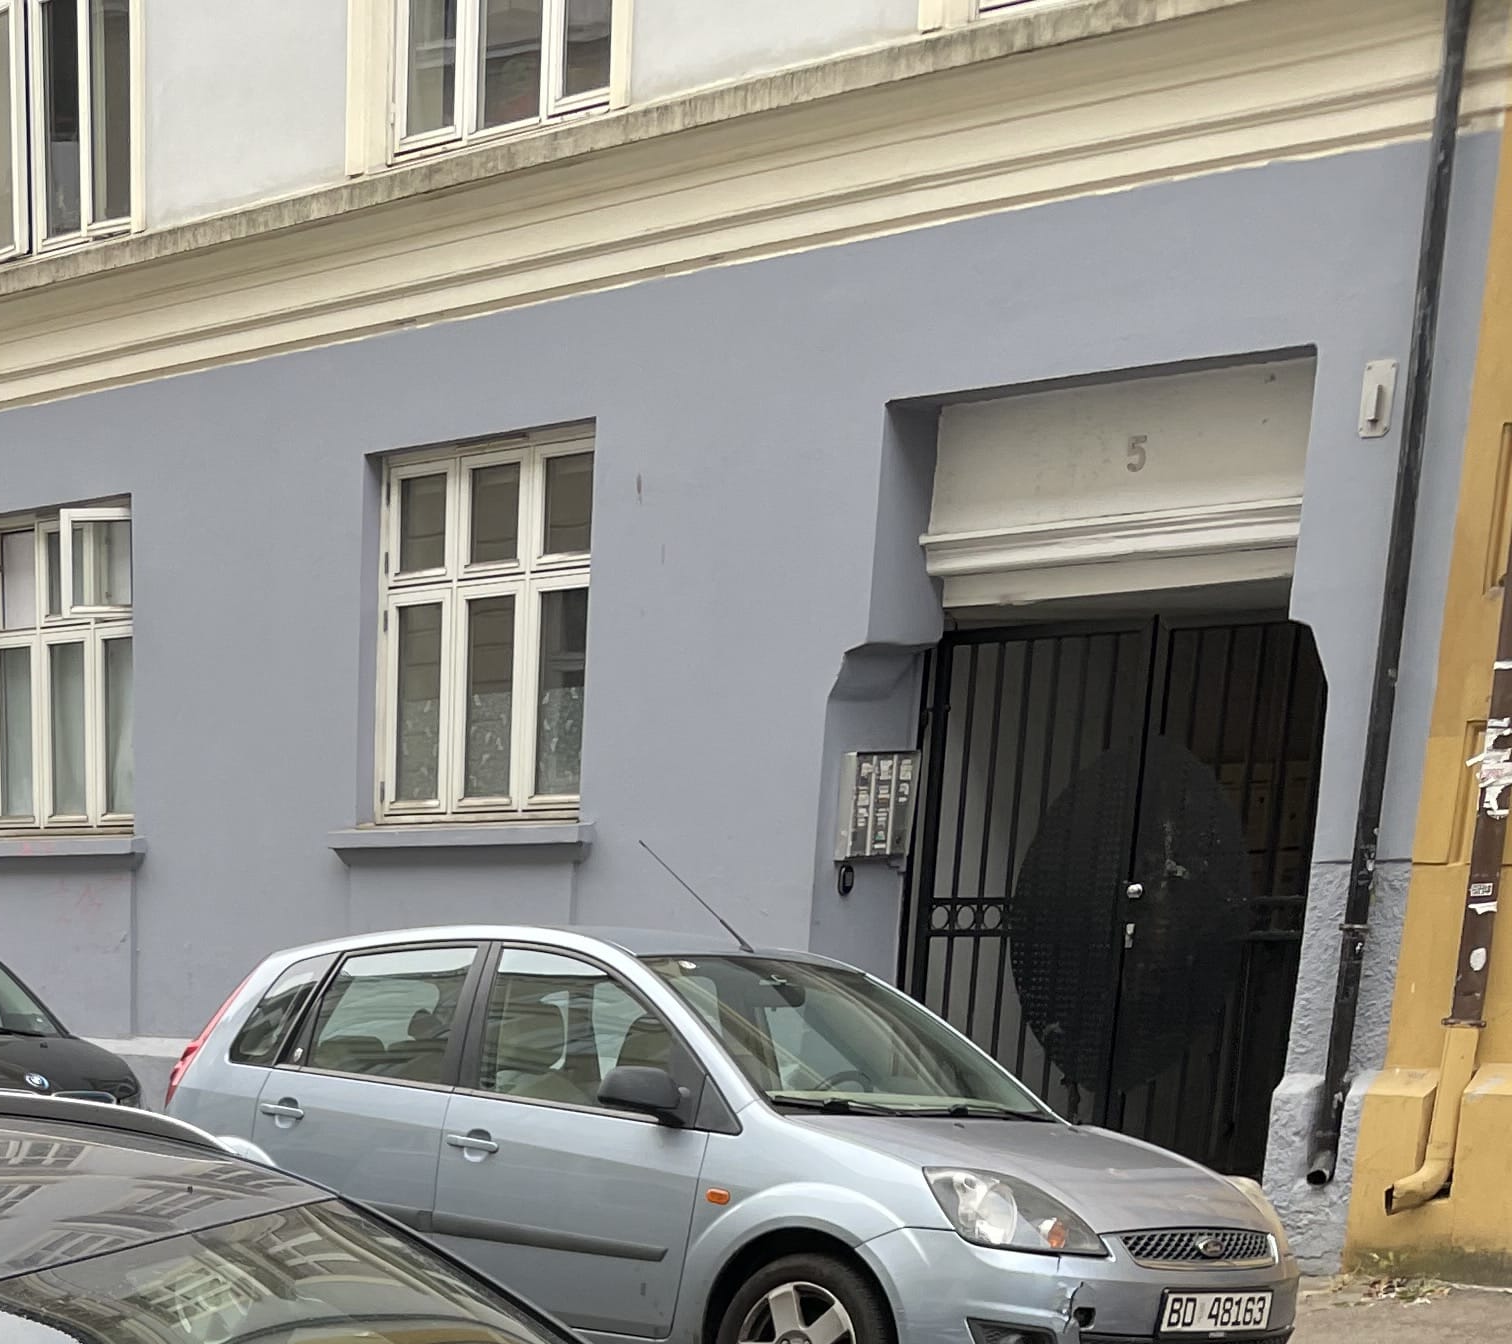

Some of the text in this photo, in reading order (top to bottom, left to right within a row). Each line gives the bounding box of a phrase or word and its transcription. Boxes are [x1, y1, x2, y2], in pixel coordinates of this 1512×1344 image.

[1126, 434, 1148, 473] 5
[1166, 1295, 1266, 1328] BD 48163
